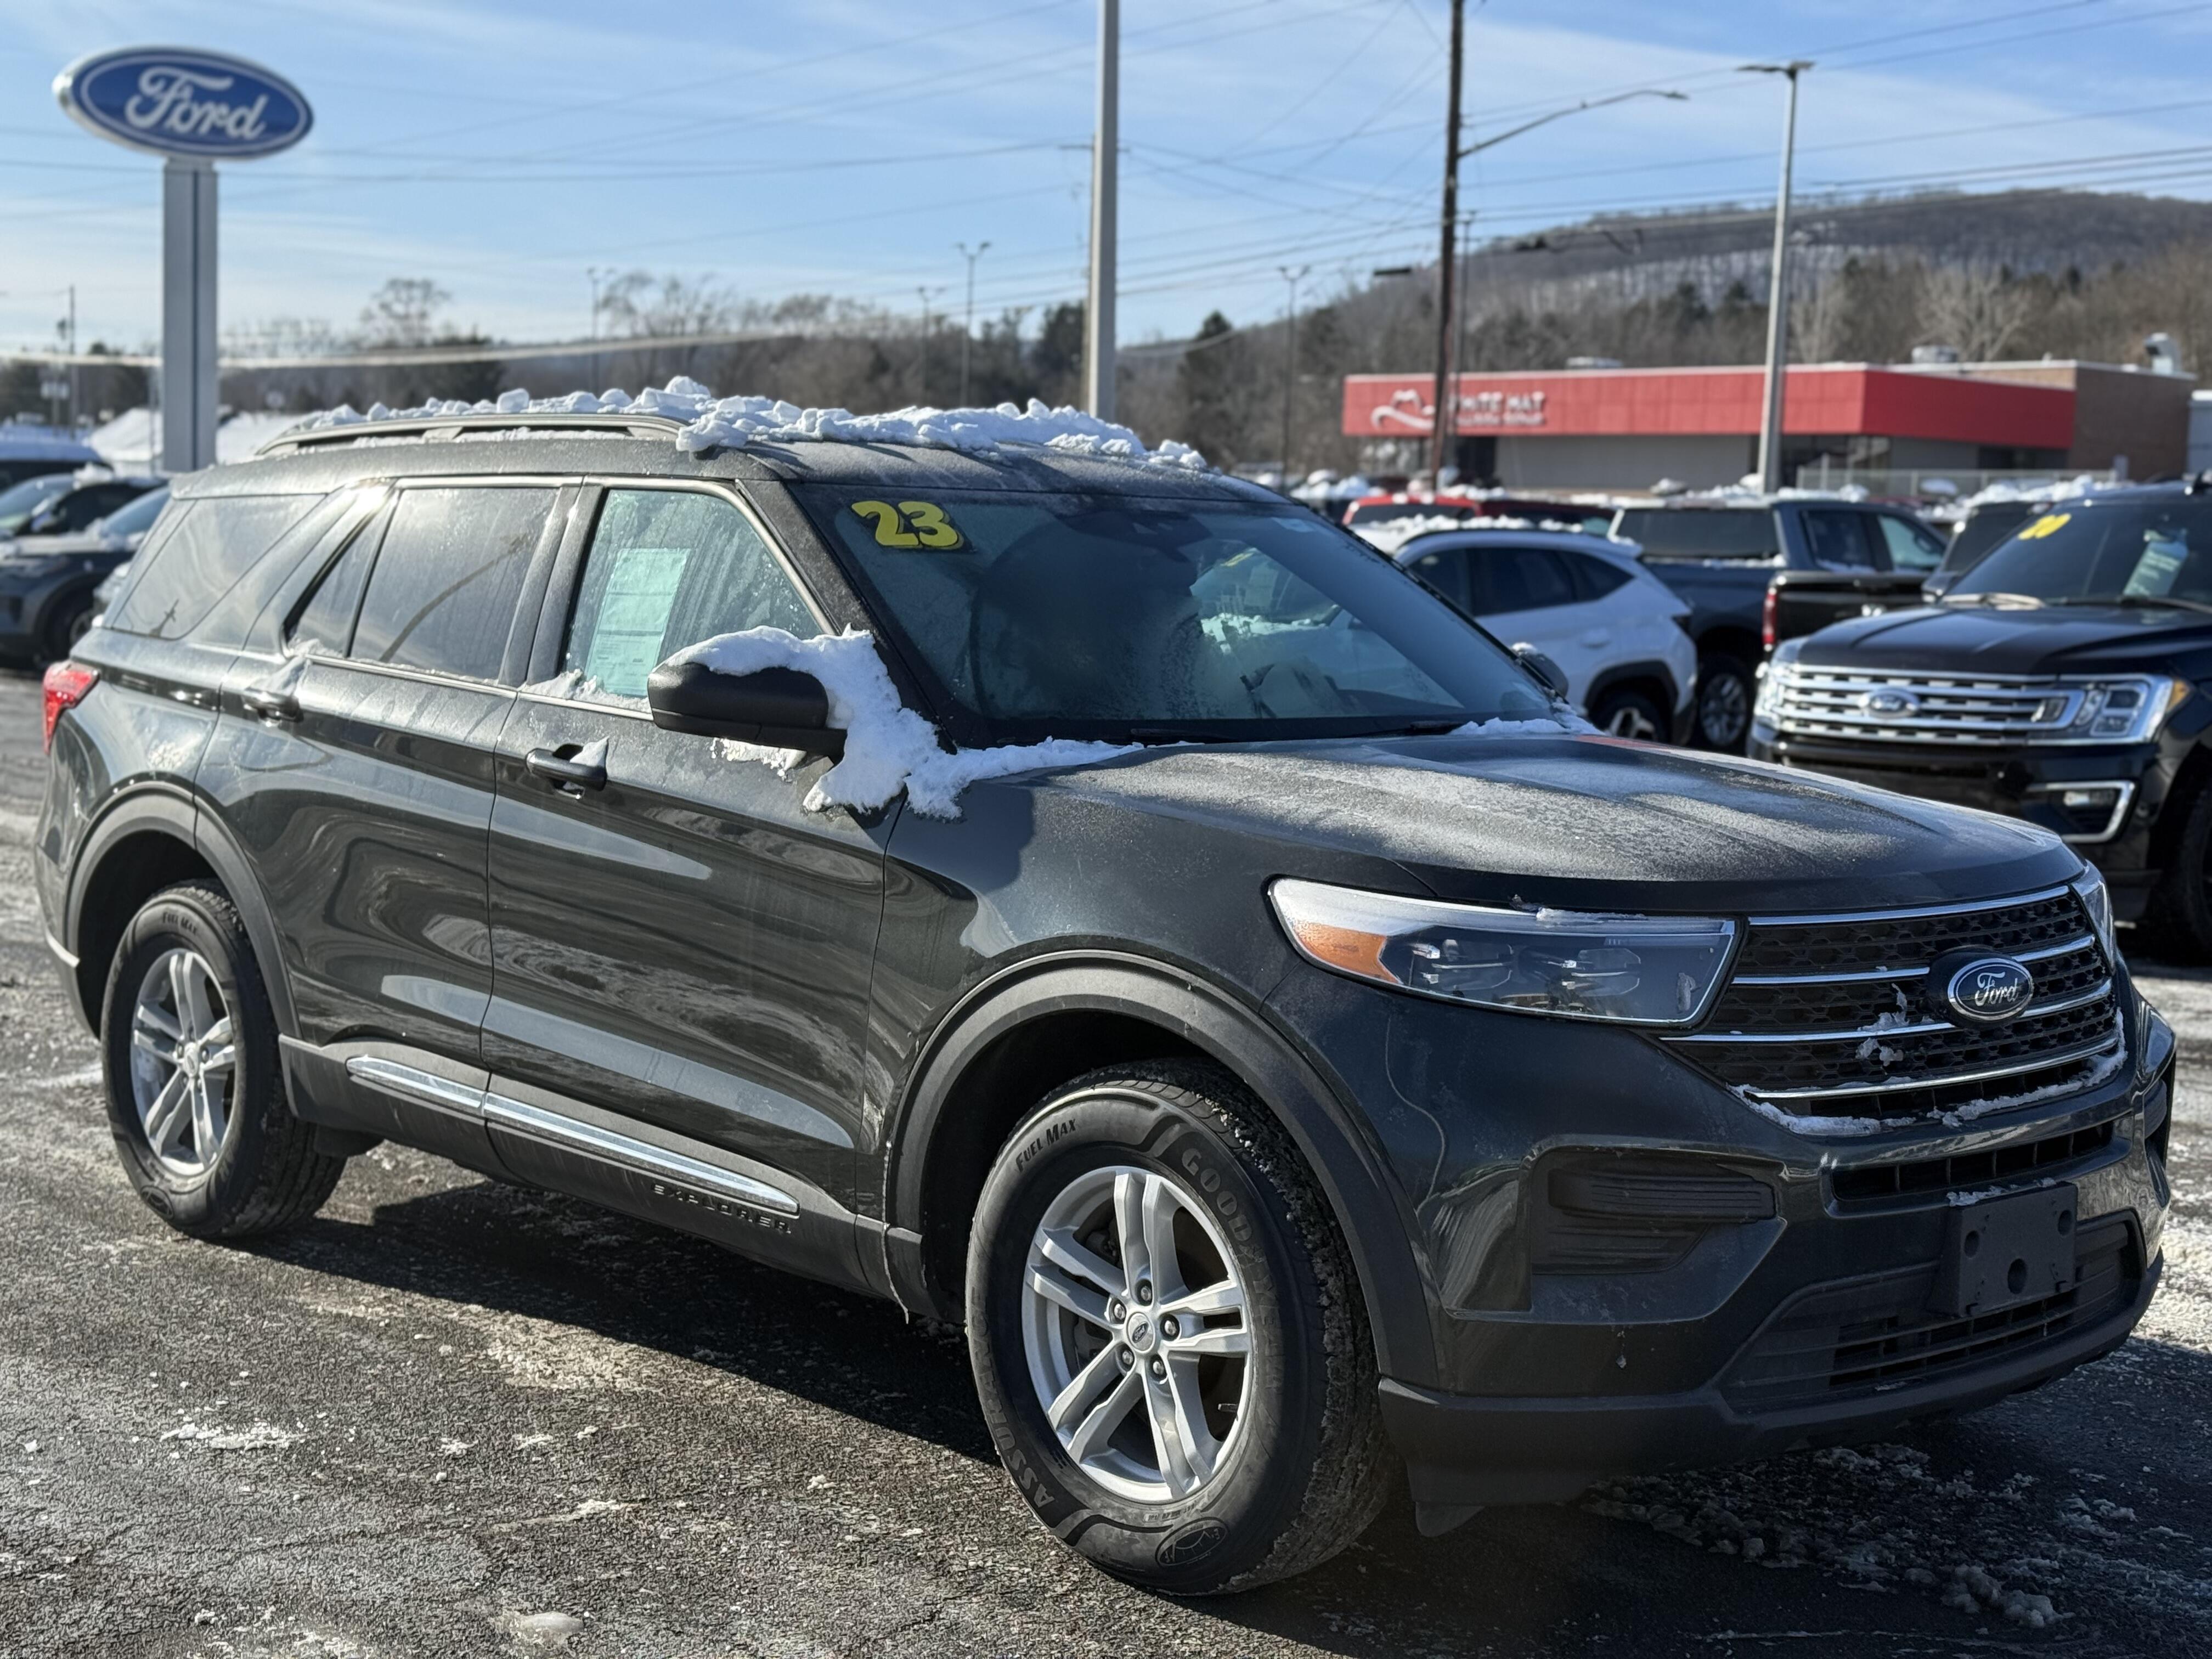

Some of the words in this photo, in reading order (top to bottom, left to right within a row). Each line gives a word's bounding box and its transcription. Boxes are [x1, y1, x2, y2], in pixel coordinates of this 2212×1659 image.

[124, 65, 269, 139] Ford
[851, 500, 963, 549] 23
[1975, 971, 2019, 1007] Ford
[1015, 1137, 1043, 1172] FUEL
[1046, 1119, 1076, 1146] MAX
[653, 1184, 792, 1234] EXPLORER
